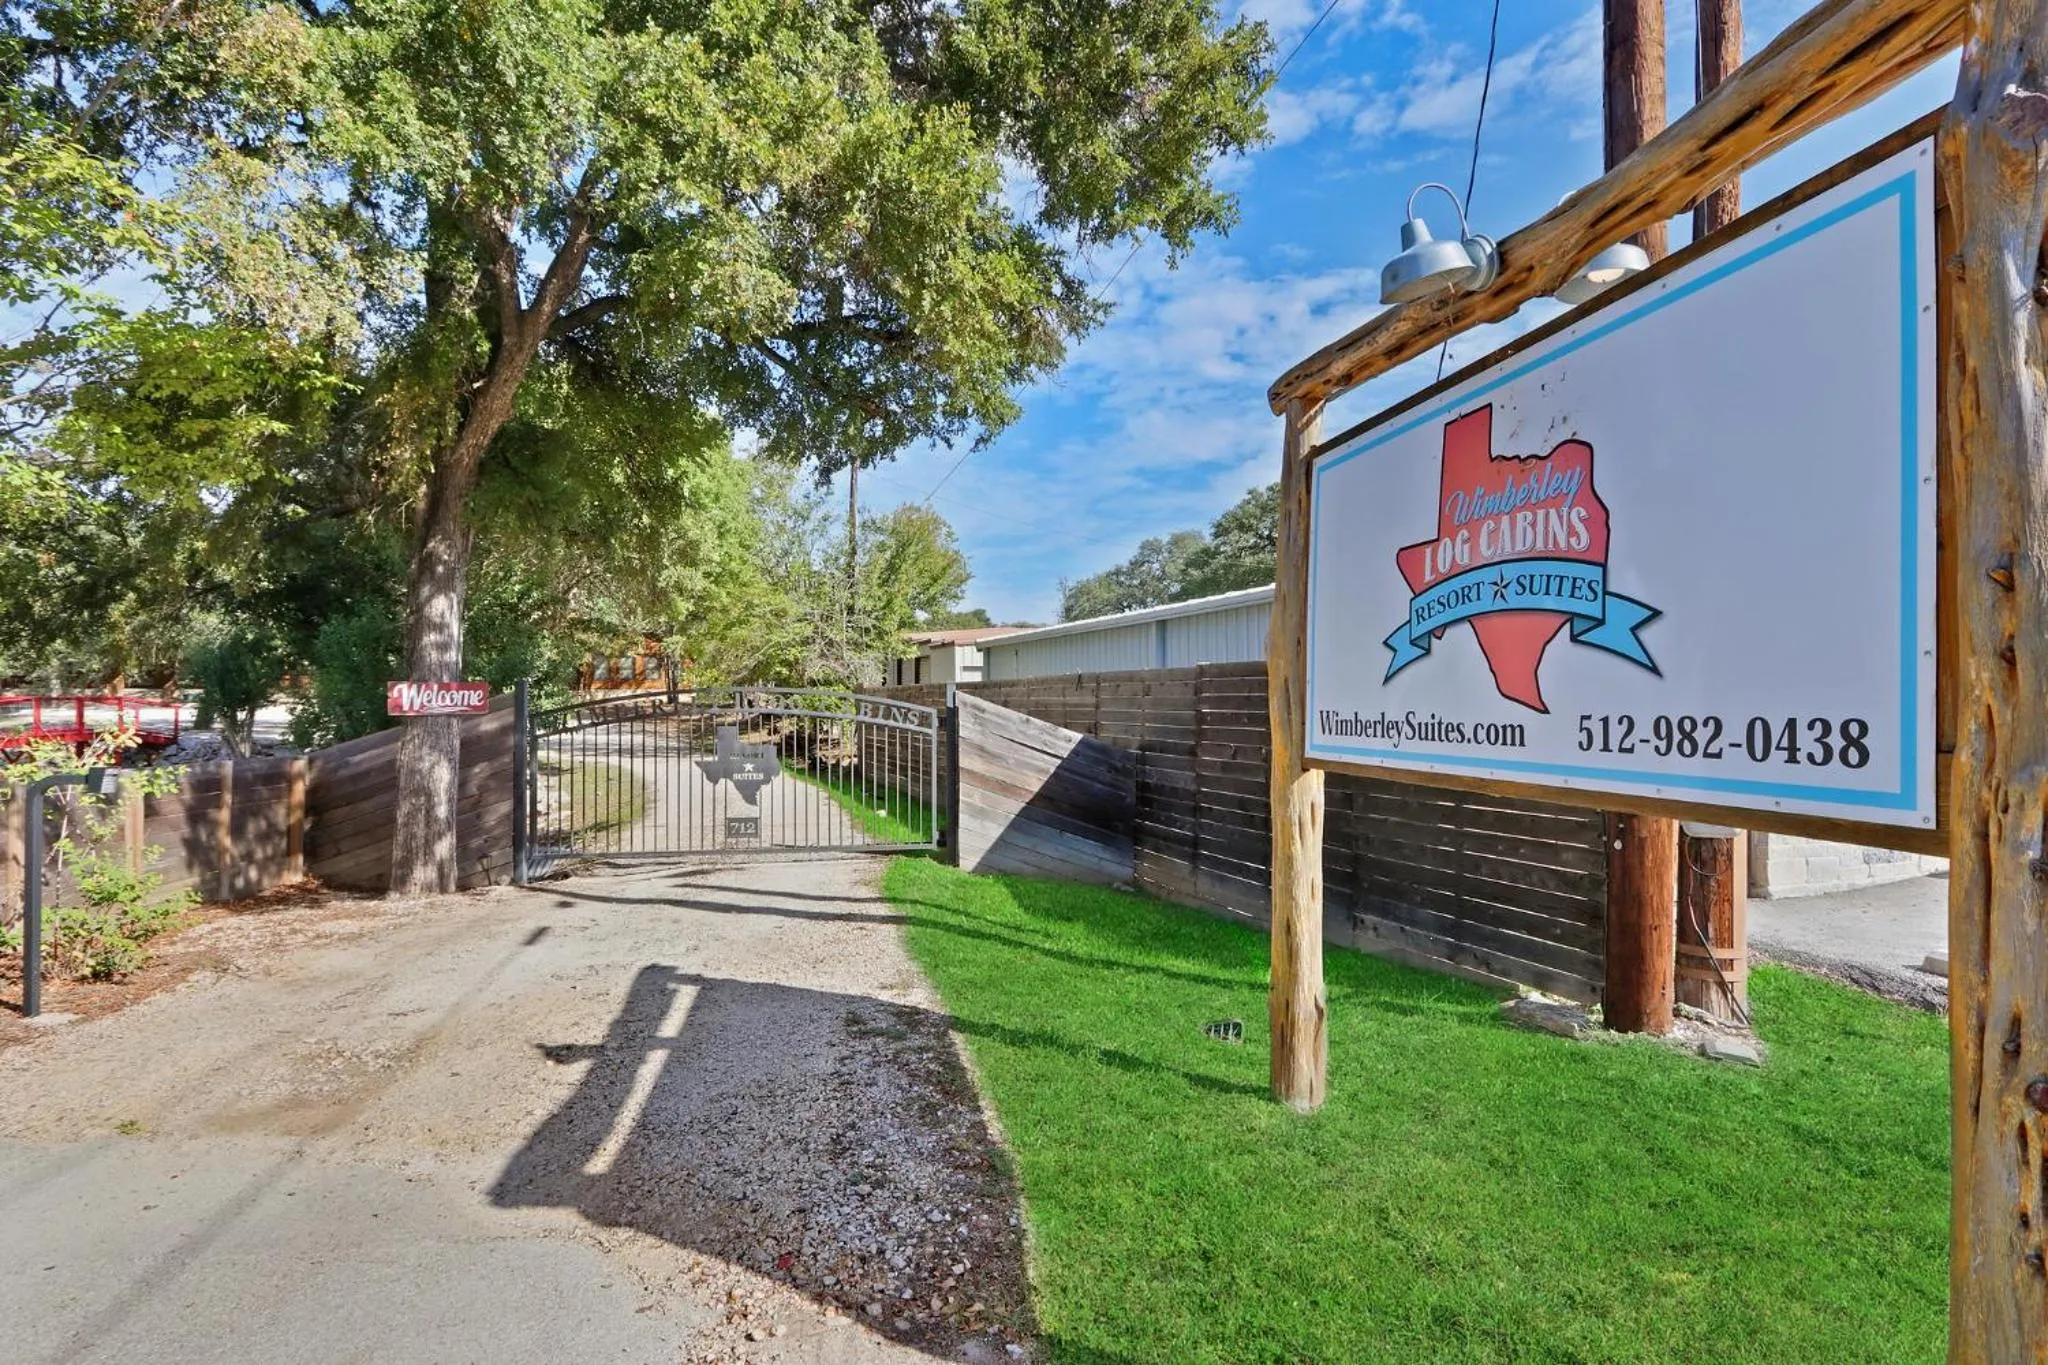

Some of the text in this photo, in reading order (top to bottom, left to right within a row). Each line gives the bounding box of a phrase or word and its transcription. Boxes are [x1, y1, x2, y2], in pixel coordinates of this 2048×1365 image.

[1445, 463, 1585, 527] Wimberley
[1422, 506, 1591, 584] LOG CABINS
[1414, 572, 1600, 627] RESORT SUITES
[392, 682, 485, 712] Welcome
[1318, 709, 1871, 770] WimberleySuites.com 512-982-0438
[732, 772, 764, 781] SUITES
[730, 822, 756, 834] 712
